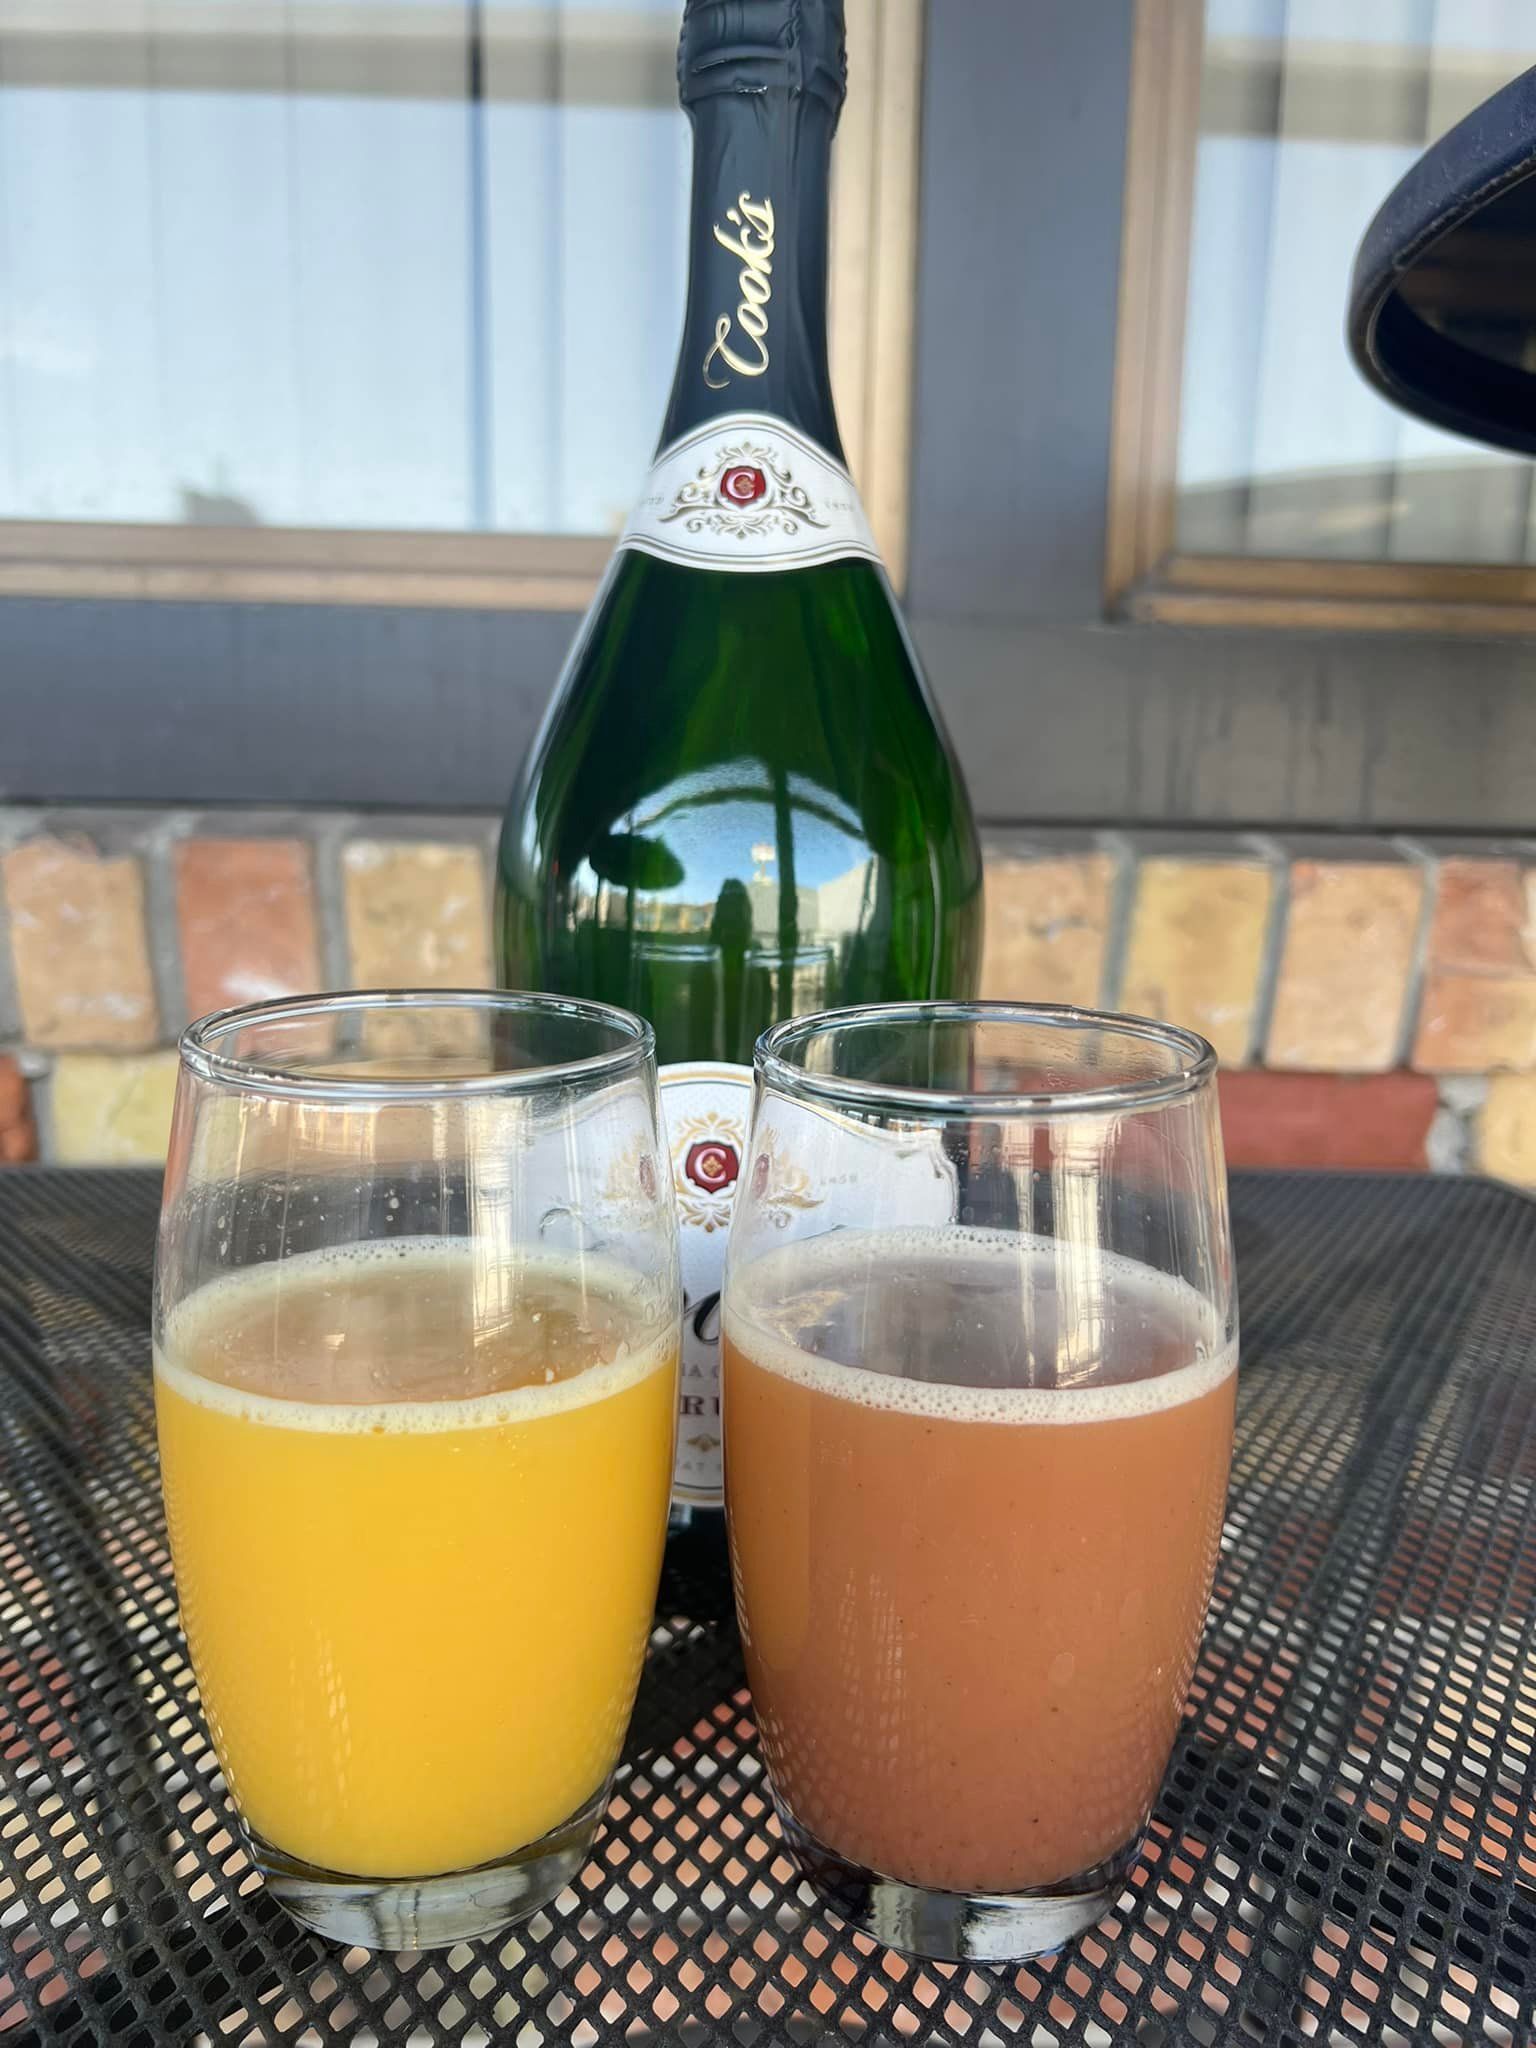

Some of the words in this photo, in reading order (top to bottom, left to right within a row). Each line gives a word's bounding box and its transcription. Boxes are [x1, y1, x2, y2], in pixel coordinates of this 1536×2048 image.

[702, 190, 776, 390] Cook's
[725, 471, 756, 500] C
[693, 1147, 727, 1185] C
